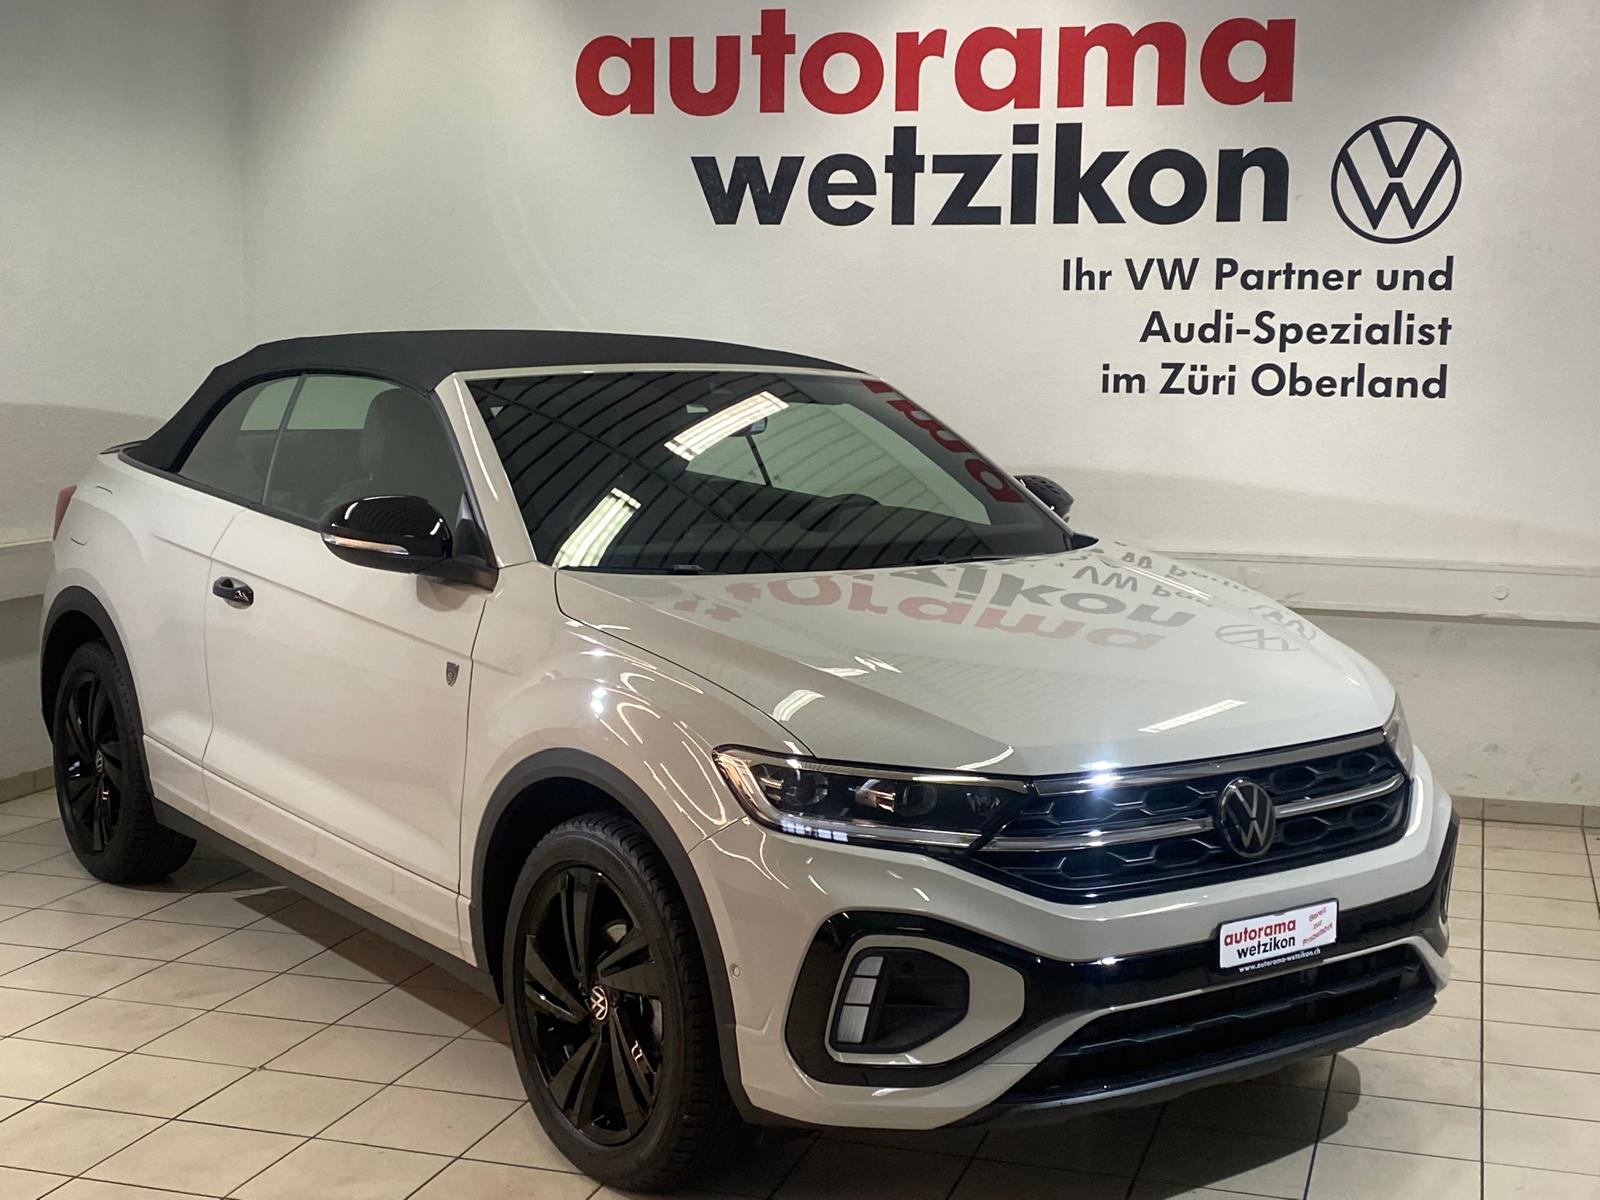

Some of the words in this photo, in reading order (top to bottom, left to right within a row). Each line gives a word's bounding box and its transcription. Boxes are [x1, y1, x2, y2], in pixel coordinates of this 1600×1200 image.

[575, 9, 1297, 117] autorama
[690, 122, 1290, 227] wetzikon
[1331, 115, 1462, 244] VW
[1062, 257, 1112, 291] Ihr
[1125, 258, 1200, 291] VW
[1215, 258, 1362, 291] Partner
[1376, 255, 1454, 291] und
[1139, 309, 1453, 353] Audi-Spezialist
[1101, 364, 1146, 394] im
[1159, 362, 1237, 396] Züri
[1251, 362, 1448, 399] Oberland
[1224, 919, 1296, 947] autorama
[1236, 936, 1296, 960] wetzikon
[1238, 947, 1321, 973] www.autorama-wetzikon.ch
